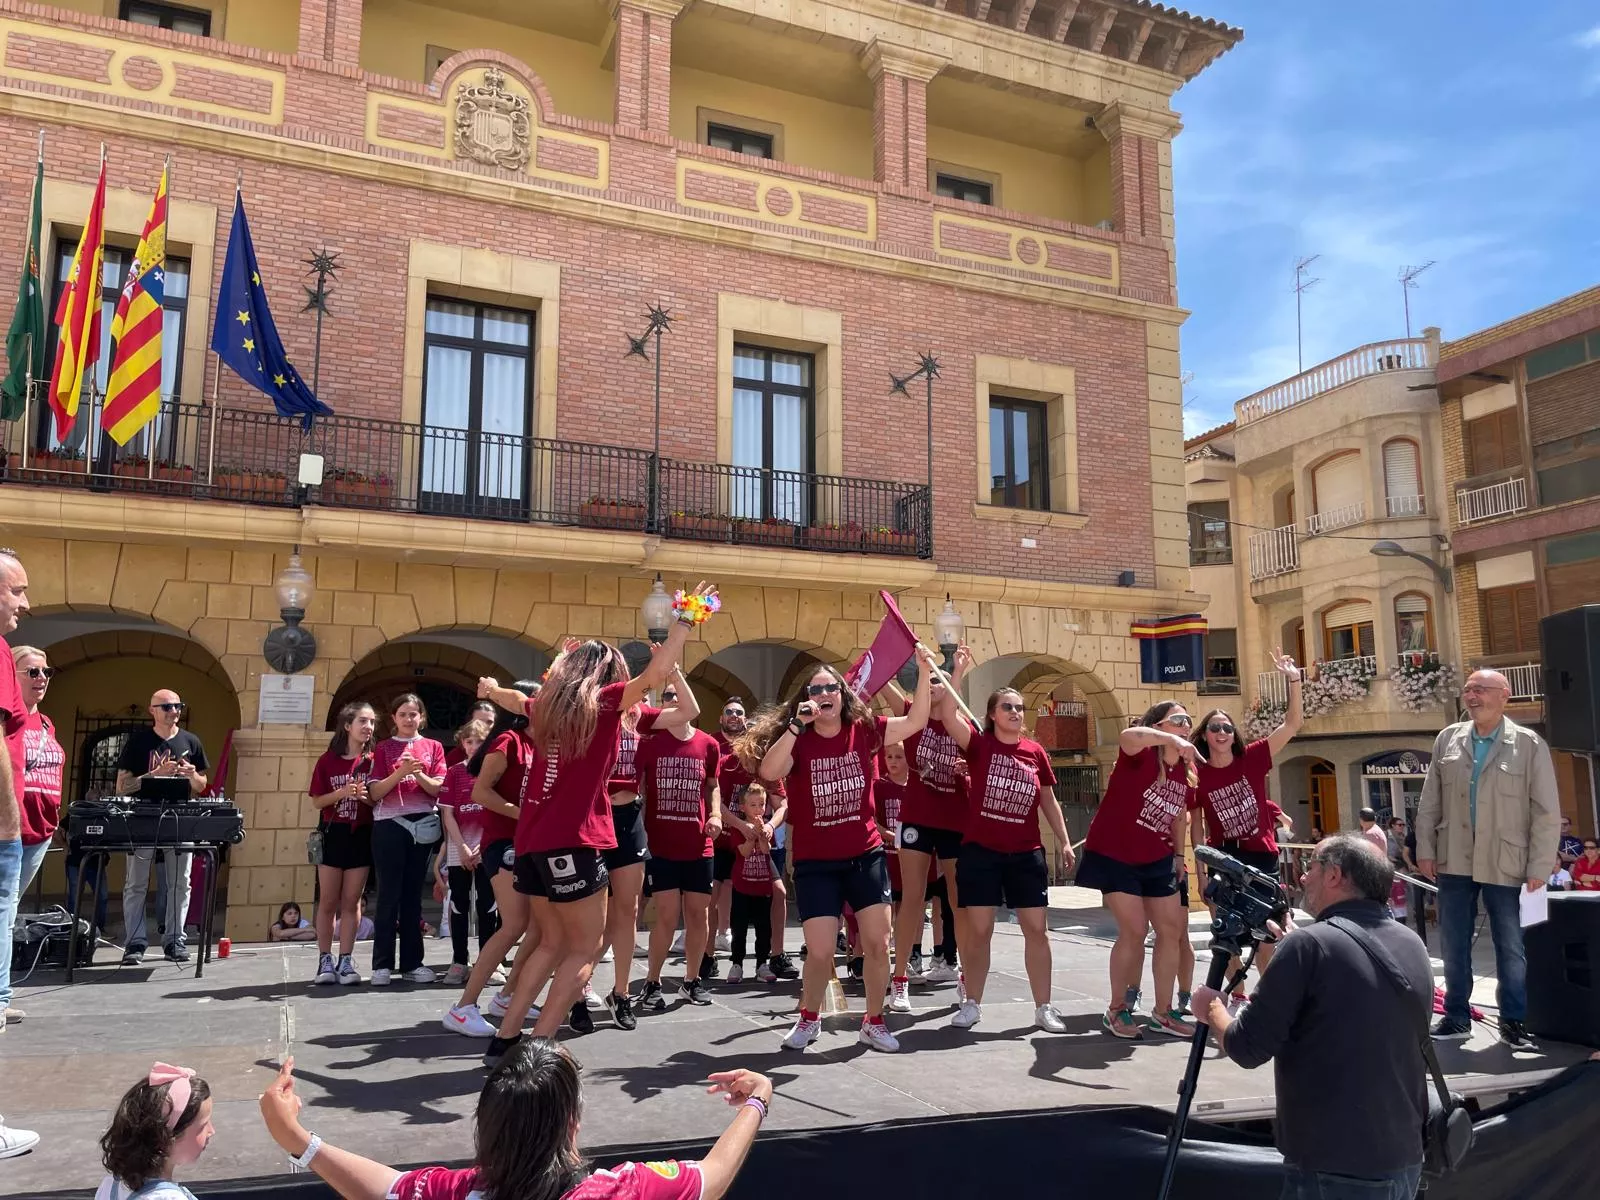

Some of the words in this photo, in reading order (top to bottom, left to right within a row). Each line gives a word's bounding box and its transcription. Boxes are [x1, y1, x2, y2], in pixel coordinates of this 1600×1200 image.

[1164, 665, 1186, 674] POLICIA
[810, 751, 860, 771] CAMPEONAS
[1366, 764, 1400, 775] Manos
[812, 775, 865, 797] CAMPEONAS
[986, 775, 1037, 797] CAMPEONAS
[982, 796, 1031, 816] CAMPEONAS
[984, 786, 1035, 808] CAMPEONAS
